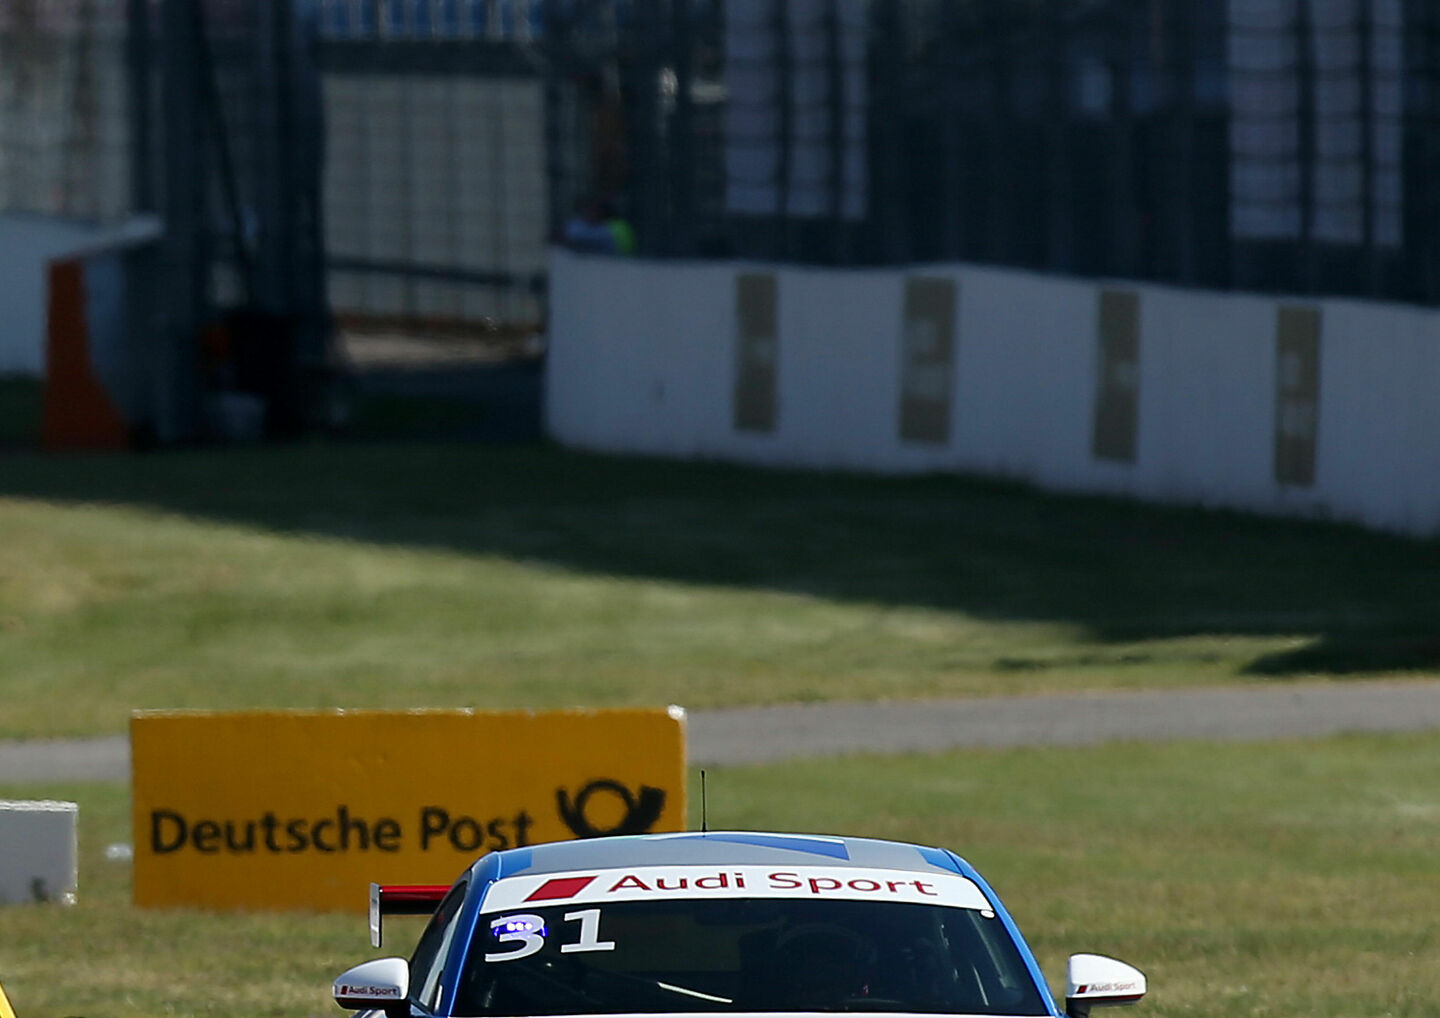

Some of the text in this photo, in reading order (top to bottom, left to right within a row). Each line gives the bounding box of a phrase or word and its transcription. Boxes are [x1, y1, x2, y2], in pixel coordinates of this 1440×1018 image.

[150, 806, 534, 855] Deutsche Post
[606, 871, 939, 897] Audi Sport
[483, 908, 616, 963] 31
[348, 985, 397, 996] Audi Sport
[1089, 982, 1136, 992] Audi Sport
